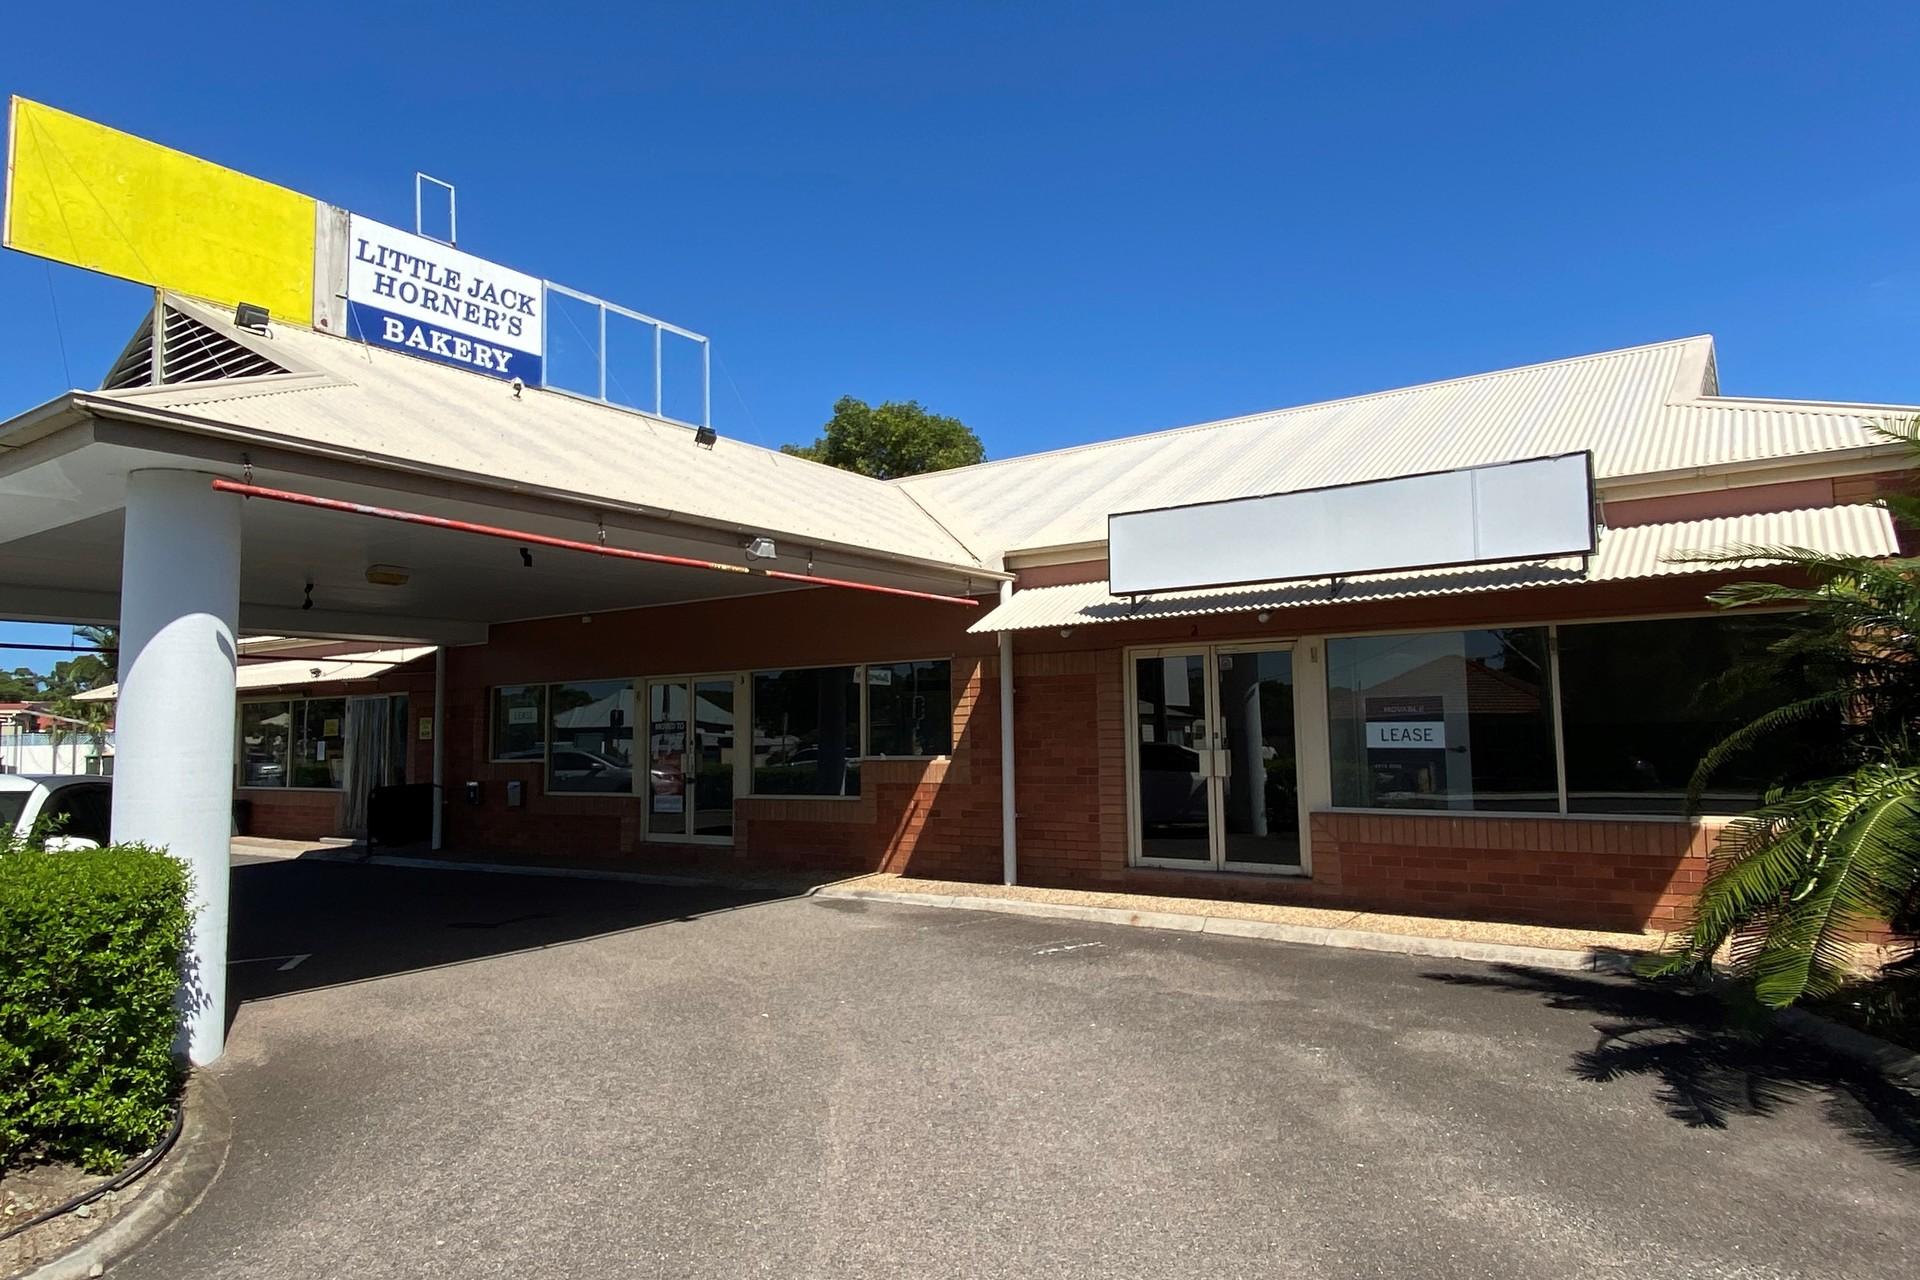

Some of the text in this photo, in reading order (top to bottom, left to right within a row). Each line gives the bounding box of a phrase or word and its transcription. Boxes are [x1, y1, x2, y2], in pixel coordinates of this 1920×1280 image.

[355, 238, 536, 317] LITTLE JACK
[372, 271, 523, 337] HORNER'S
[382, 316, 514, 373] BAKERY
[1381, 727, 1433, 742] LEASE
